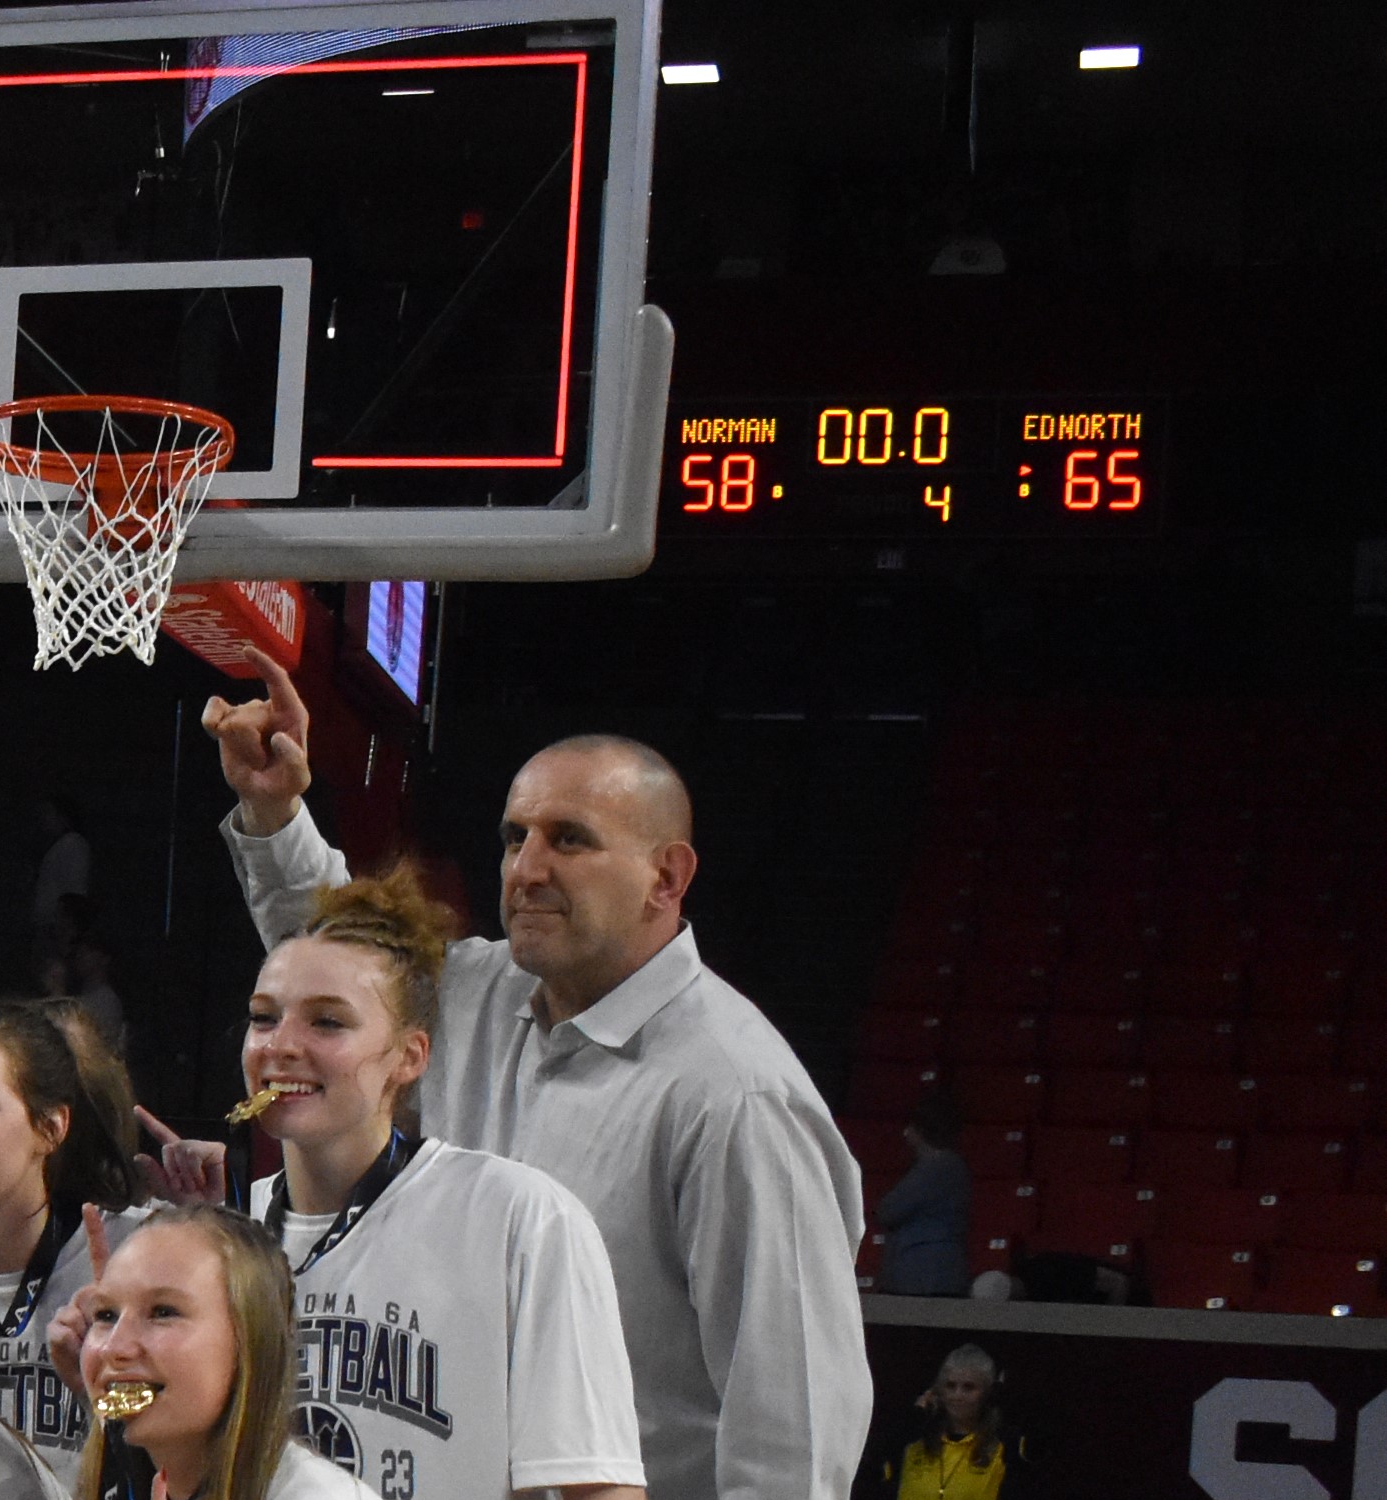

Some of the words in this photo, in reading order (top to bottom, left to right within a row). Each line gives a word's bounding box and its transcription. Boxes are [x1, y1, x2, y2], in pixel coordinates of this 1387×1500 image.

[682, 417, 776, 444] NORMAN
[817, 408, 949, 465] 00.0
[682, 455, 755, 512] 58
[924, 485, 950, 522] 4
[1065, 450, 1141, 511] 65
[381, 1449, 415, 1500] 23
